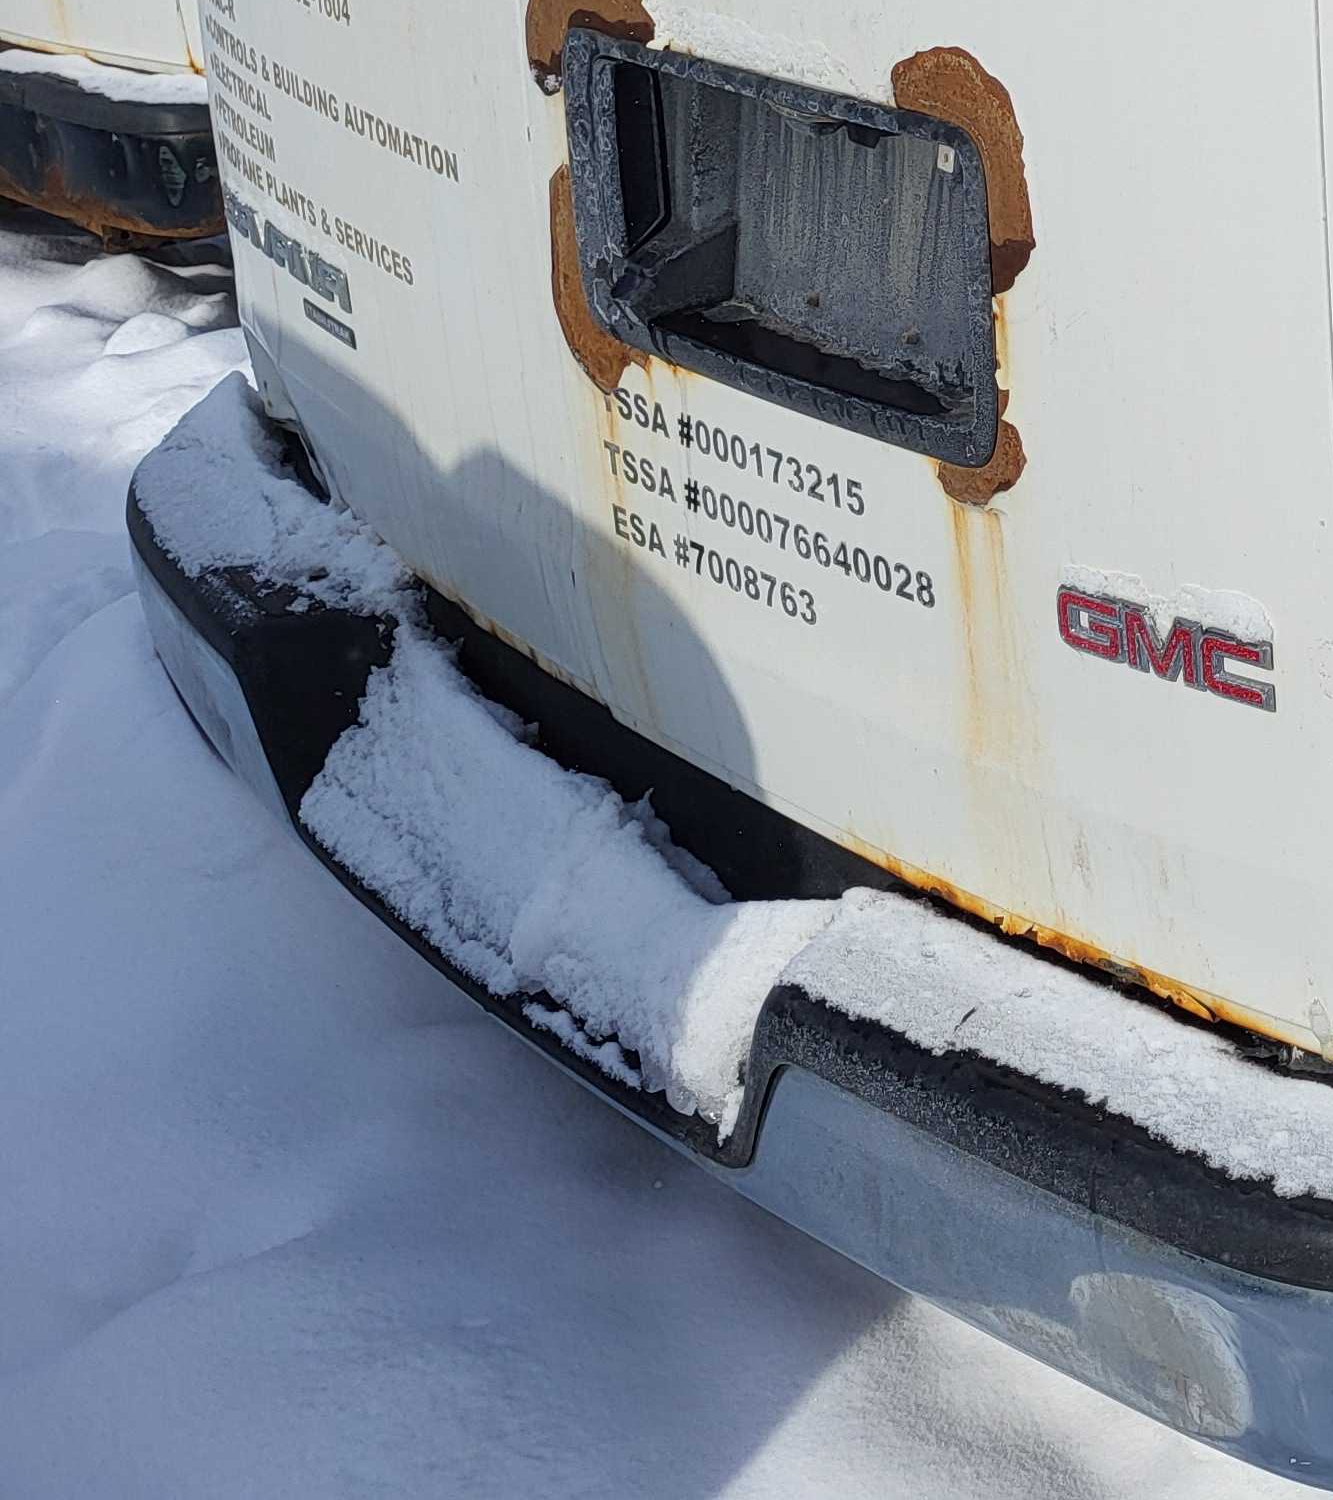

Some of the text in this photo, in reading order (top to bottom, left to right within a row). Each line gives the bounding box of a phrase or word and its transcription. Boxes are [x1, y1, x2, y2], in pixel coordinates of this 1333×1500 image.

[209, 14, 459, 182] CONTROLS & BUILDING AUTOMATION
[213, 52, 272, 121] ELECTRICAL
[218, 92, 276, 164] PETROLEUM
[265, 171, 316, 227] PLANTS
[321, 208, 331, 237] &
[335, 217, 413, 285] SERVICES
[677, 411, 865, 516] #000173215
[603, 439, 936, 609] TSSA #000076640028
[612, 503, 818, 626] ESA #7008763
[1057, 584, 1277, 713] GMC
